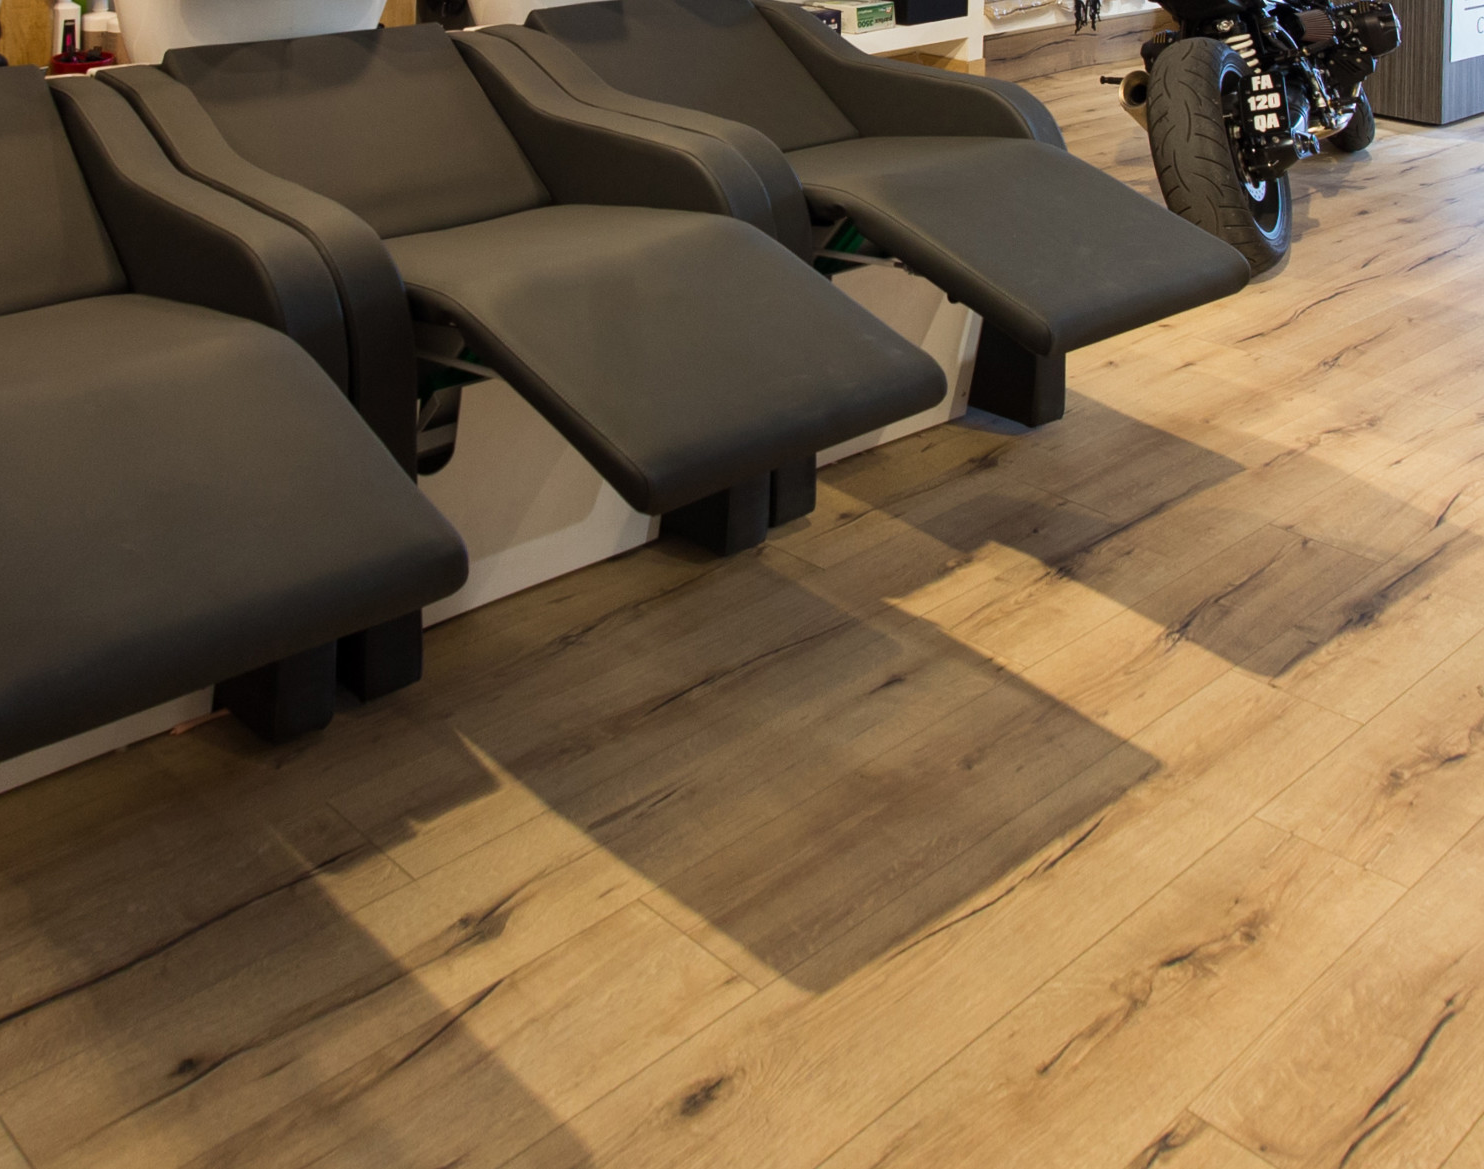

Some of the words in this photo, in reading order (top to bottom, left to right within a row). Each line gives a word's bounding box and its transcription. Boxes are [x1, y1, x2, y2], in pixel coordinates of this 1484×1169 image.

[1251, 74, 1273, 91] FA
[1247, 92, 1281, 111] 120
[1253, 112, 1280, 133] QA
